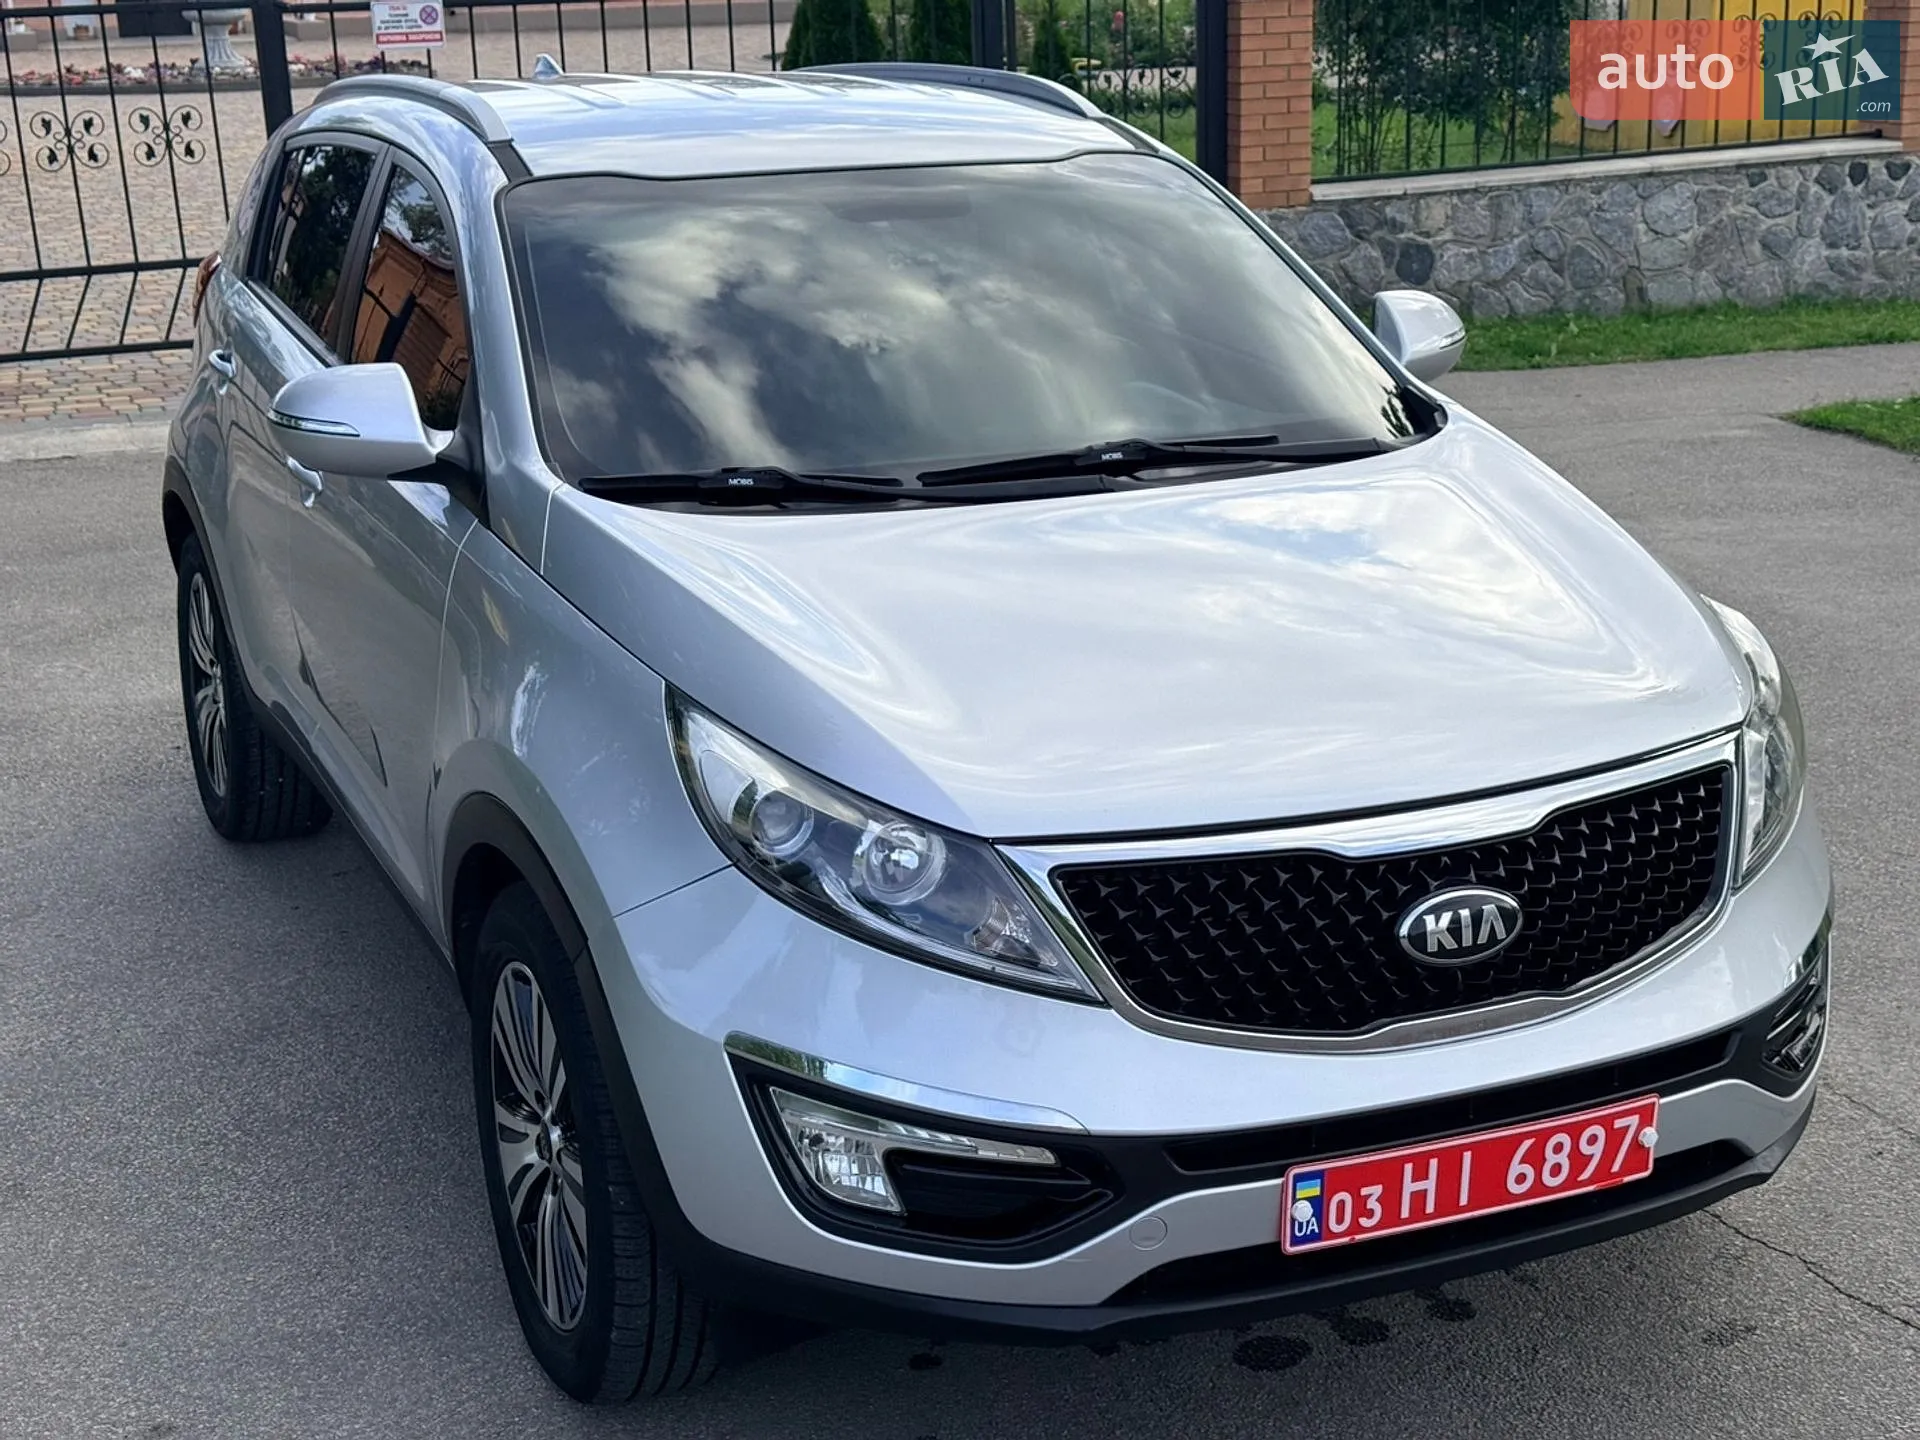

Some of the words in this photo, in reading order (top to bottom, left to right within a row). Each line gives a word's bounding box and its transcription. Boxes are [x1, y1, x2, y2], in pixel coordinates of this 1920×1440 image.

[728, 478, 754, 486] MOBIS
[1422, 903, 1507, 953] KIA
[1328, 1184, 1383, 1234] 03
[1506, 1114, 1641, 1195] 6897
[1294, 1216, 1319, 1237] UA
